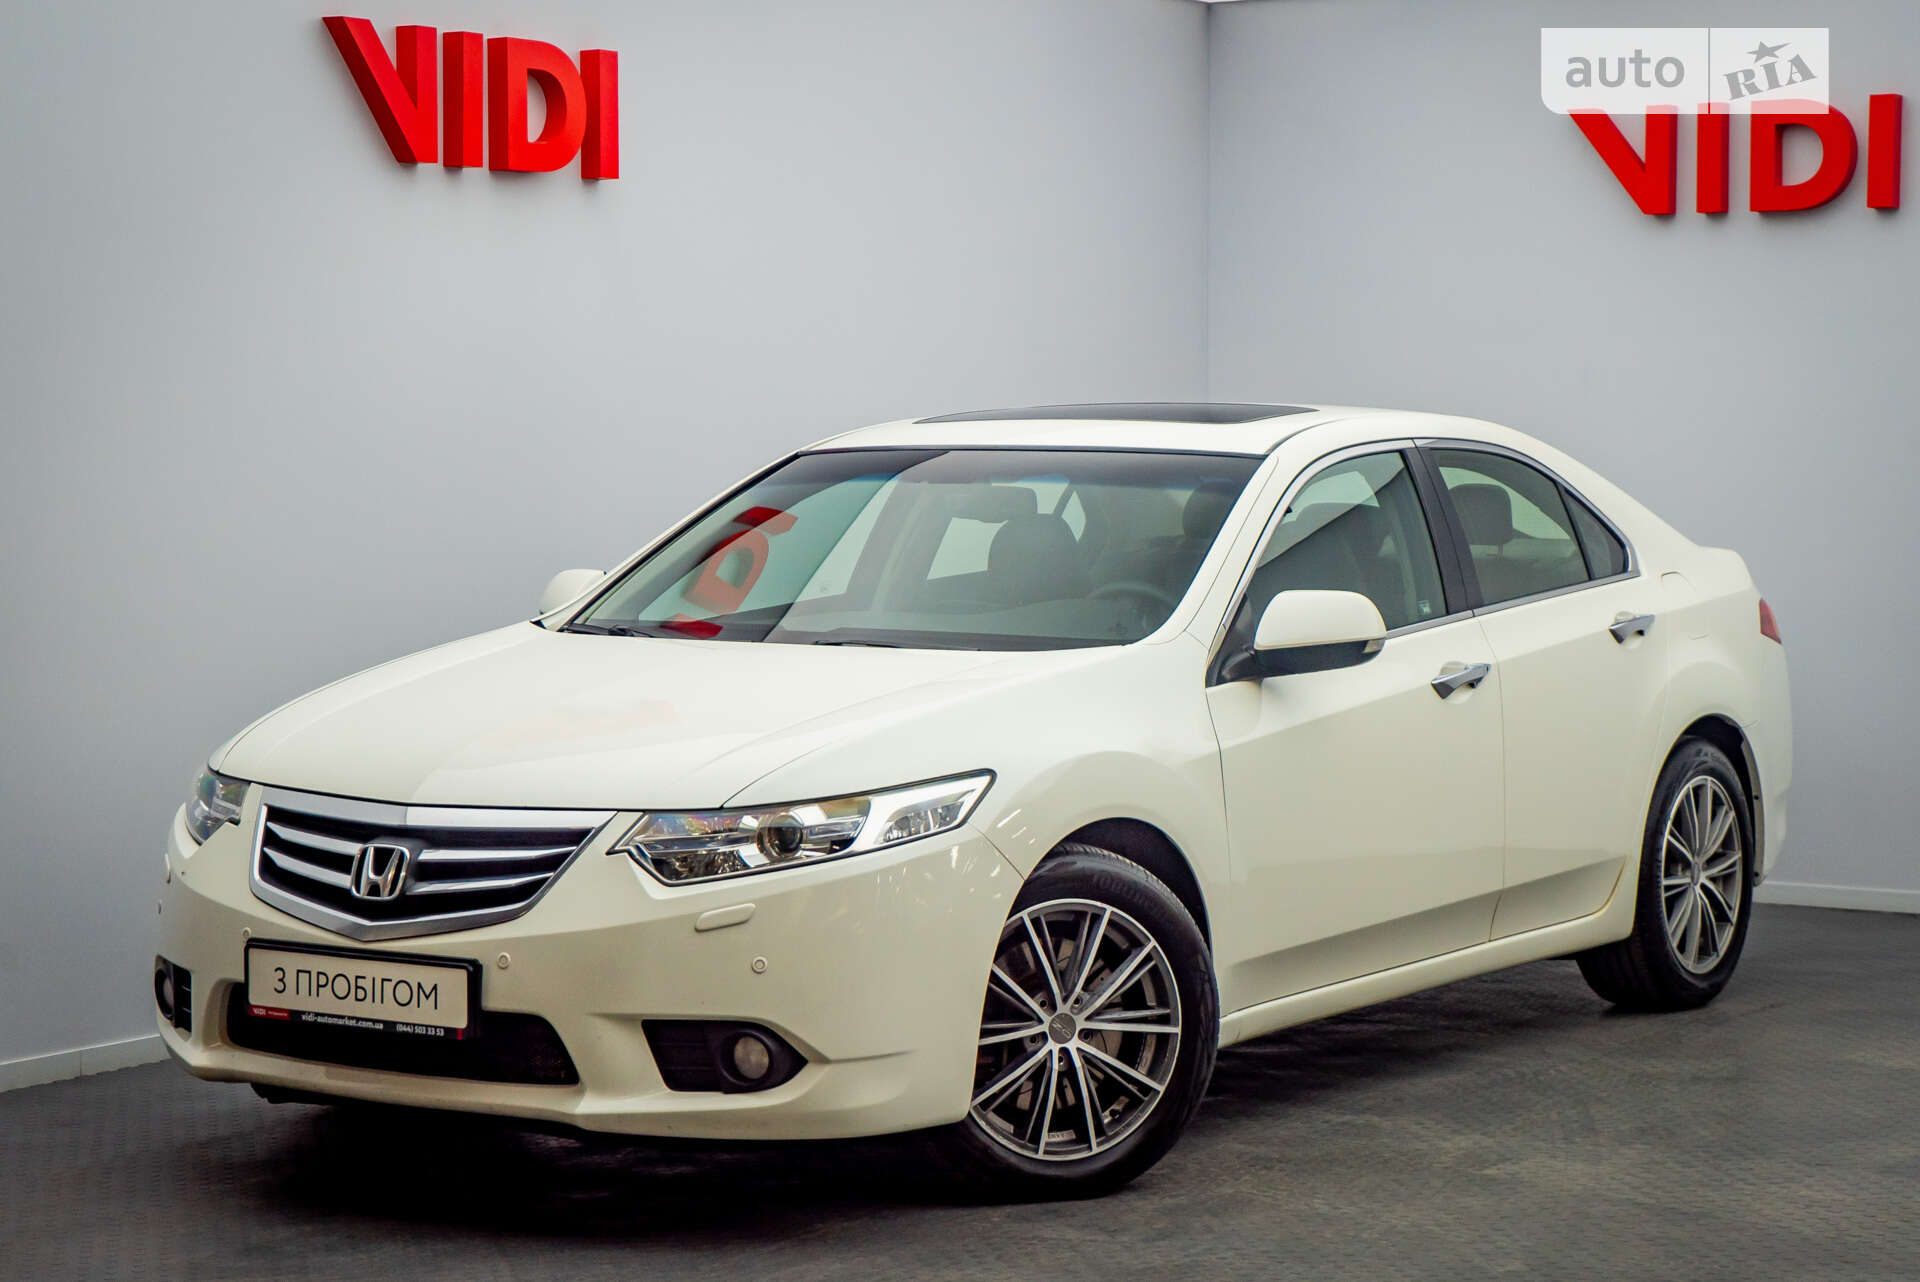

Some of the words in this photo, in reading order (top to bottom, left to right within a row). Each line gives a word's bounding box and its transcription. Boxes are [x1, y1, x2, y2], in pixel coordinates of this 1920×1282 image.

[322, 16, 619, 180] VIDI
[1567, 93, 1903, 215] VIDI
[273, 966, 287, 995] З
[295, 969, 439, 1010] ПРОБІГОМ
[302, 1013, 384, 1030] vidi-automarket.com.ua
[396, 1023, 414, 1034] (044)
[414, 1025, 426, 1035] 503
